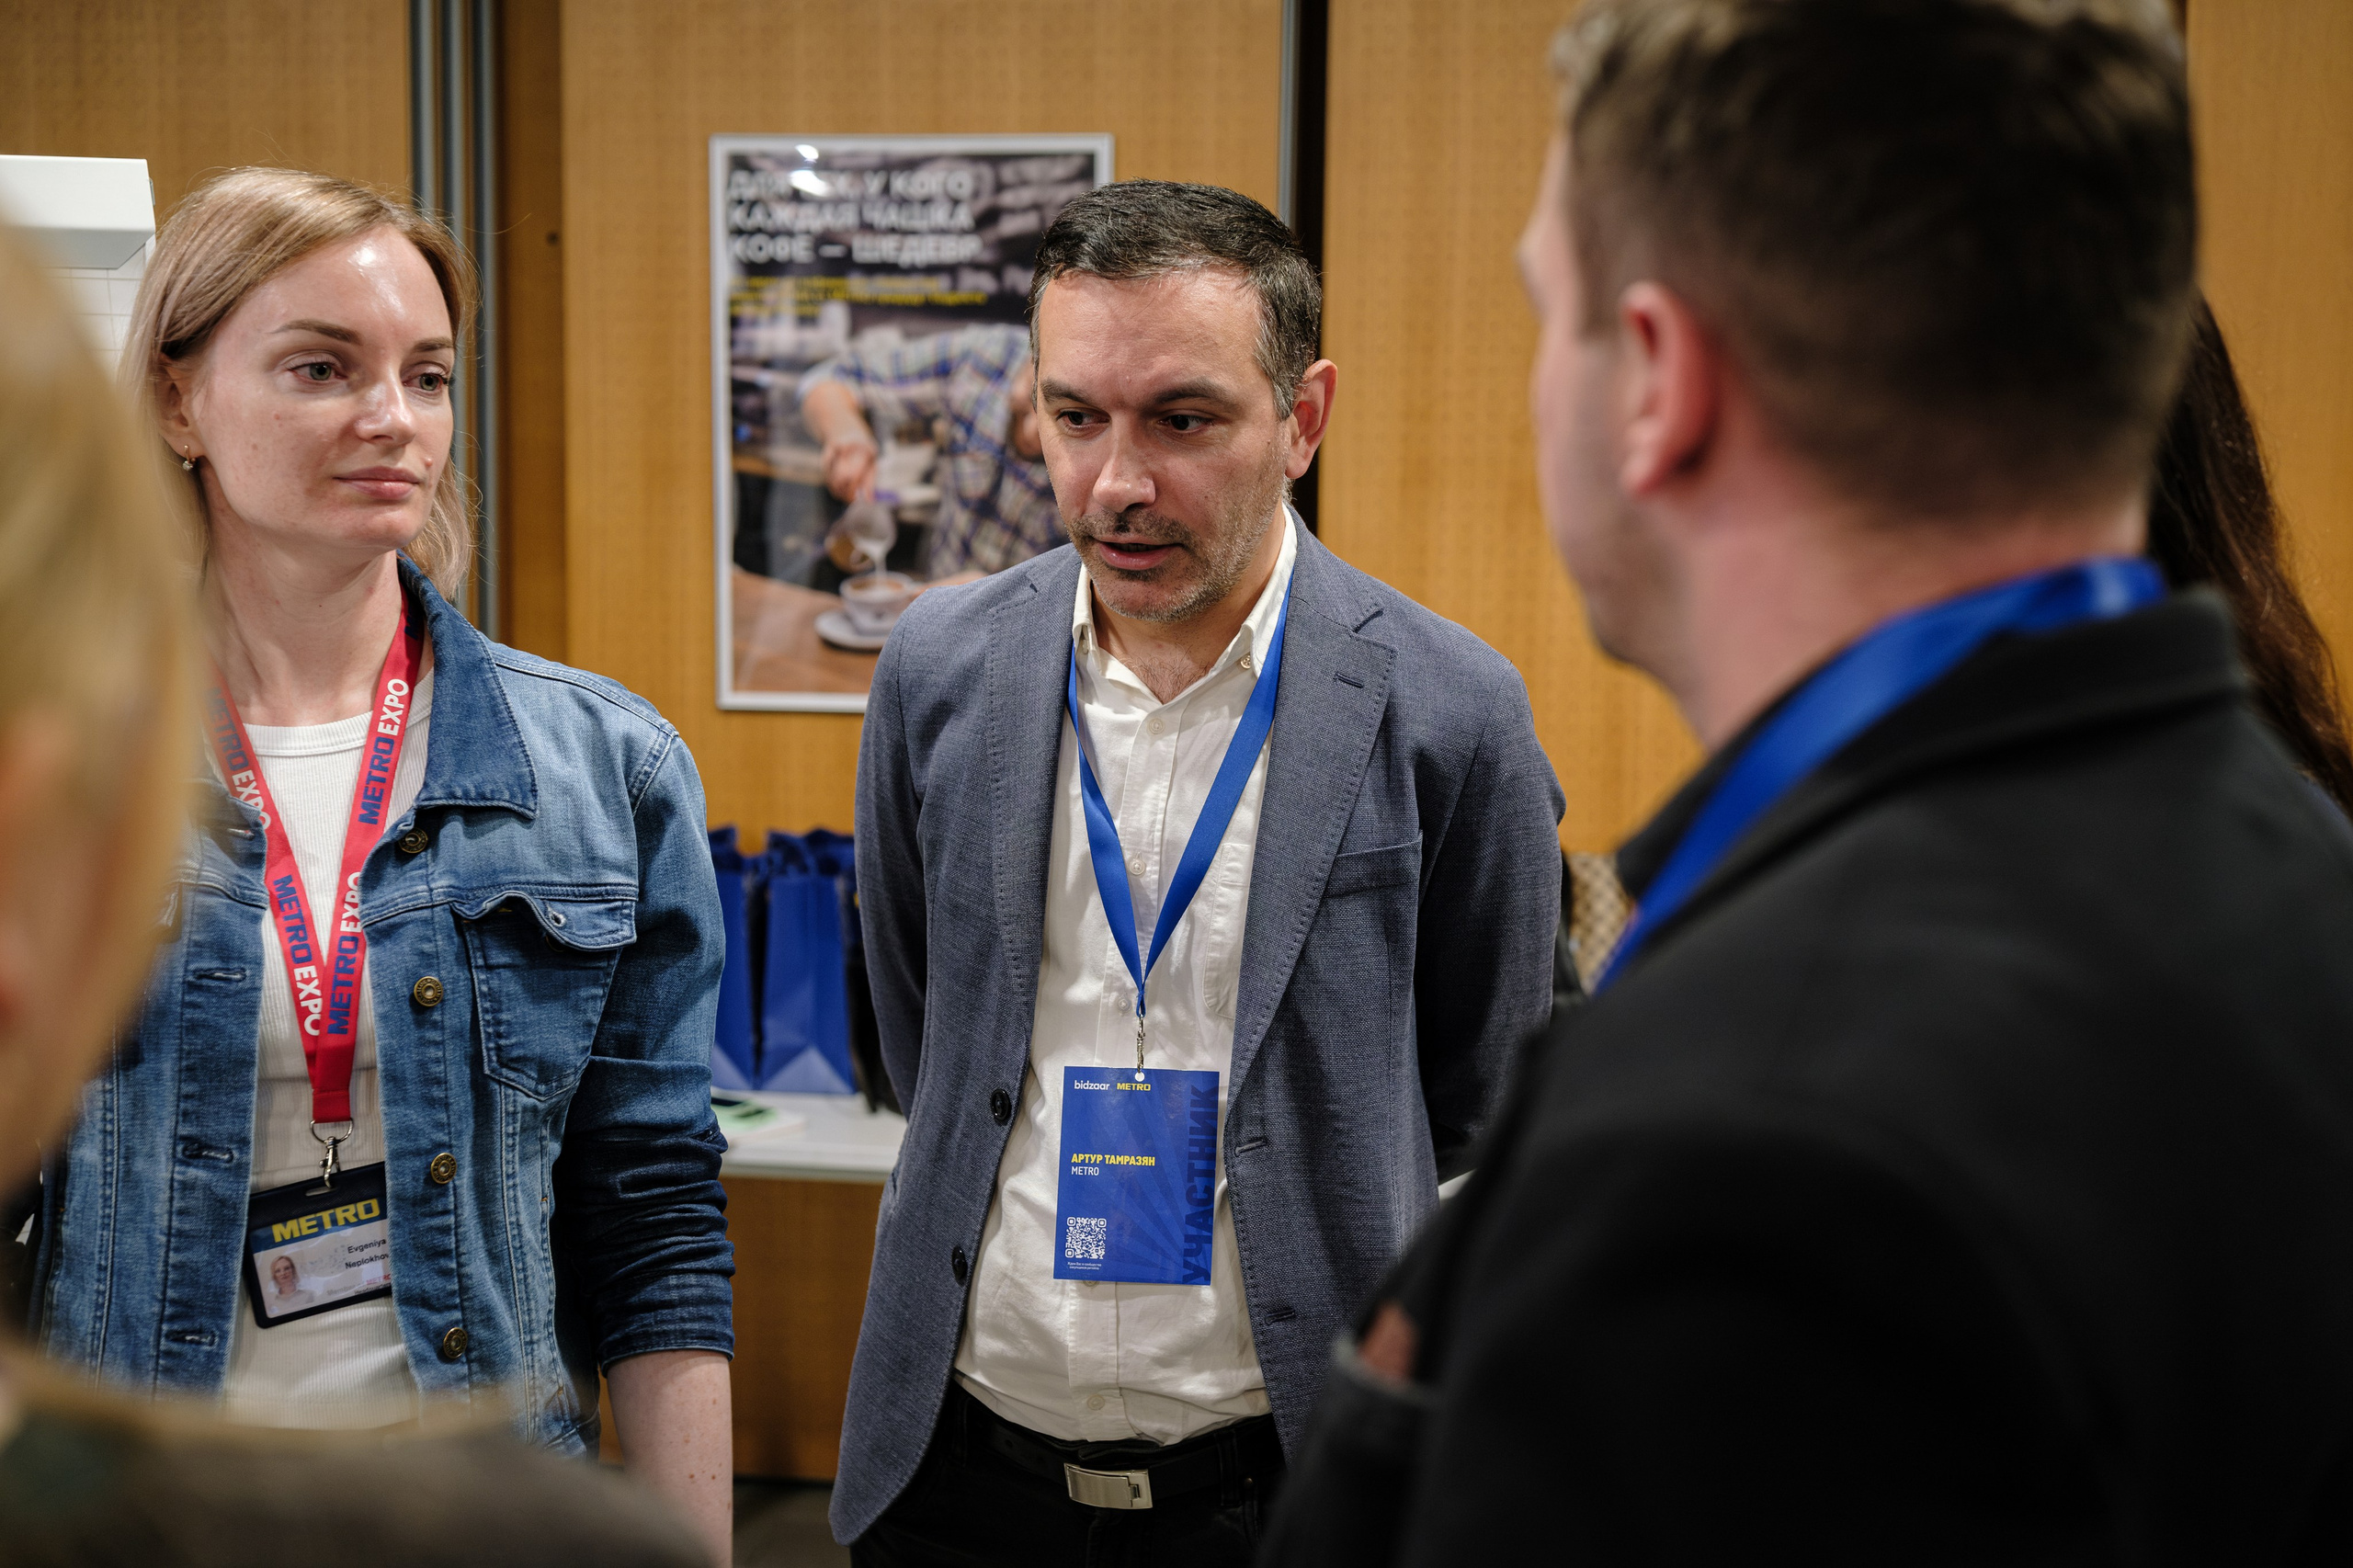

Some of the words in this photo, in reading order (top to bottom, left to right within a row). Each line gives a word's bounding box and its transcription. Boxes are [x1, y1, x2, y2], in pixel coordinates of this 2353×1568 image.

[731, 201, 859, 232] КАЖДАЯ
[861, 201, 975, 232] ЧАШКА
[731, 233, 814, 264] КОФЕ
[206, 687, 249, 771] METRO
[358, 736, 395, 825] METRO
[377, 678, 409, 736] EXPO
[273, 874, 313, 964] METRO
[293, 965, 323, 1036] EXPO
[327, 935, 358, 1035] METRO
[1074, 1080, 1110, 1090] bidzaar
[1117, 1083, 1152, 1091] METRO
[1071, 1153, 1103, 1164] АРТУР
[1104, 1154, 1155, 1166] ТАМРАЗЯН
[1071, 1166, 1099, 1176] METRO
[1182, 1085, 1218, 1284] УЧАСТНИК
[271, 1198, 381, 1243] METRO
[347, 1238, 387, 1254] Evgeniya
